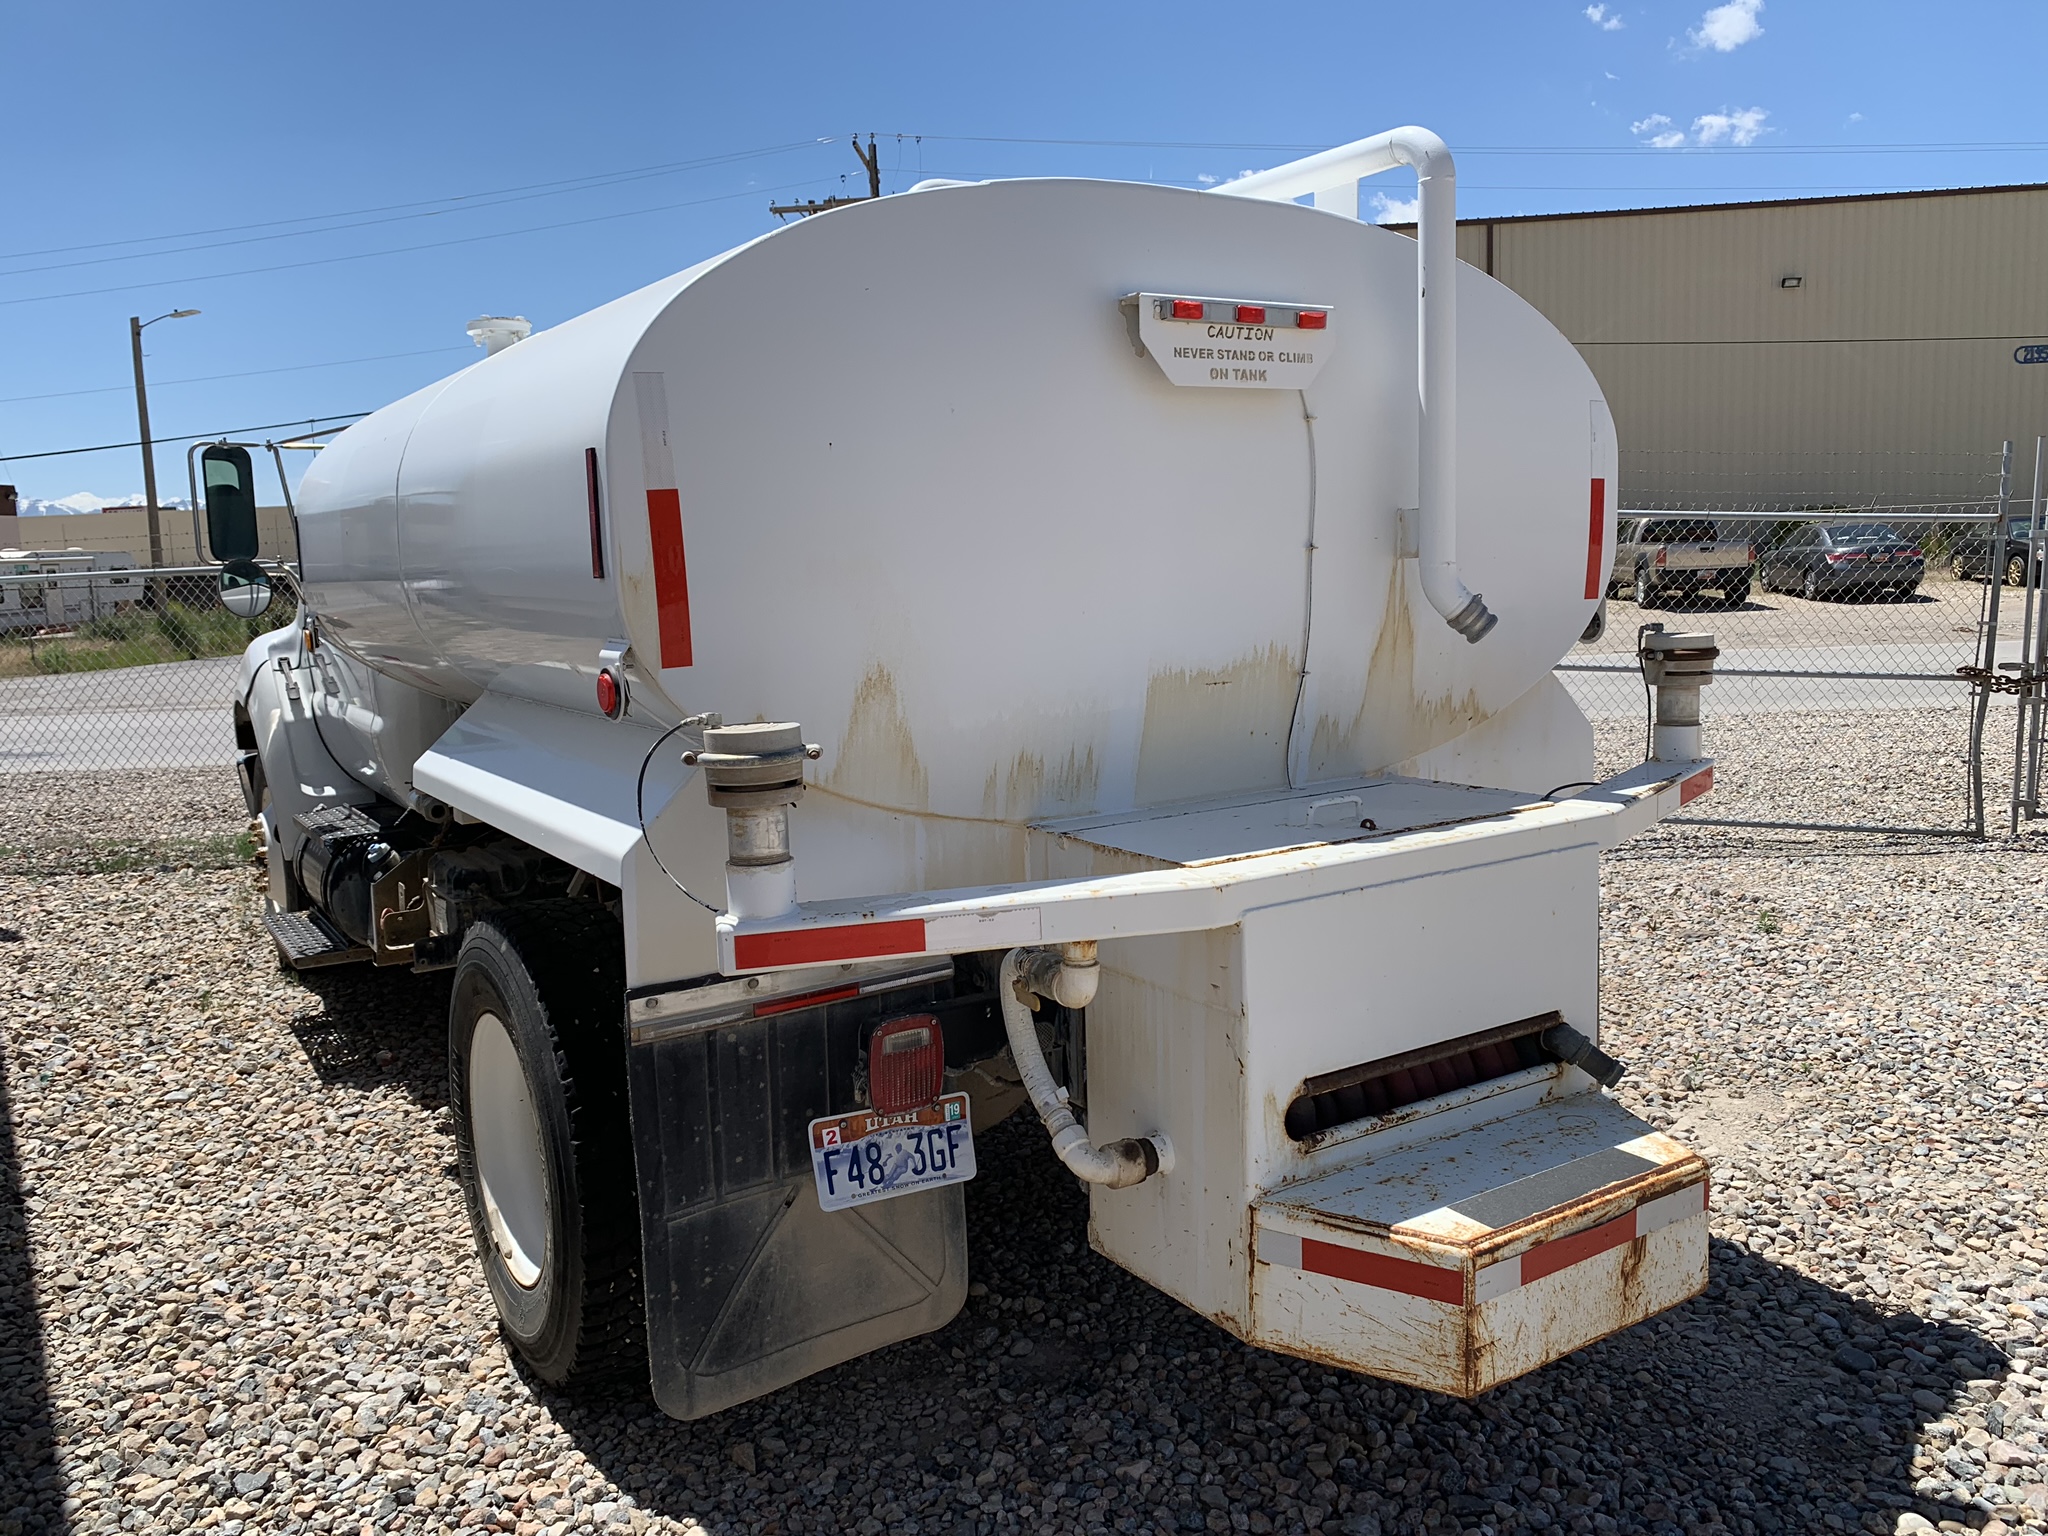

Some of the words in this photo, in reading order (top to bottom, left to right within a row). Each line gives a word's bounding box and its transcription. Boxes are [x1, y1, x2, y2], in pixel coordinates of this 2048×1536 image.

[1207, 325, 1274, 341] CAUTION
[1173, 347, 1214, 360] NEVER
[1217, 349, 1256, 361] STAND
[1258, 351, 1275, 362] OR
[1278, 352, 1314, 364] CLIMB
[1209, 367, 1229, 381] ON
[1232, 368, 1267, 382] TANK
[950, 1103, 960, 1116] 19
[864, 1112, 919, 1132] UTAH
[825, 1129, 838, 1146] 2
[823, 1142, 885, 1196] F48
[907, 1124, 962, 1176] 3GF
[857, 1186, 890, 1198] GREATEST
[891, 1182, 910, 1191] SNOW
[910, 1179, 920, 1187] ON
[921, 1175, 942, 1184] EARTH
